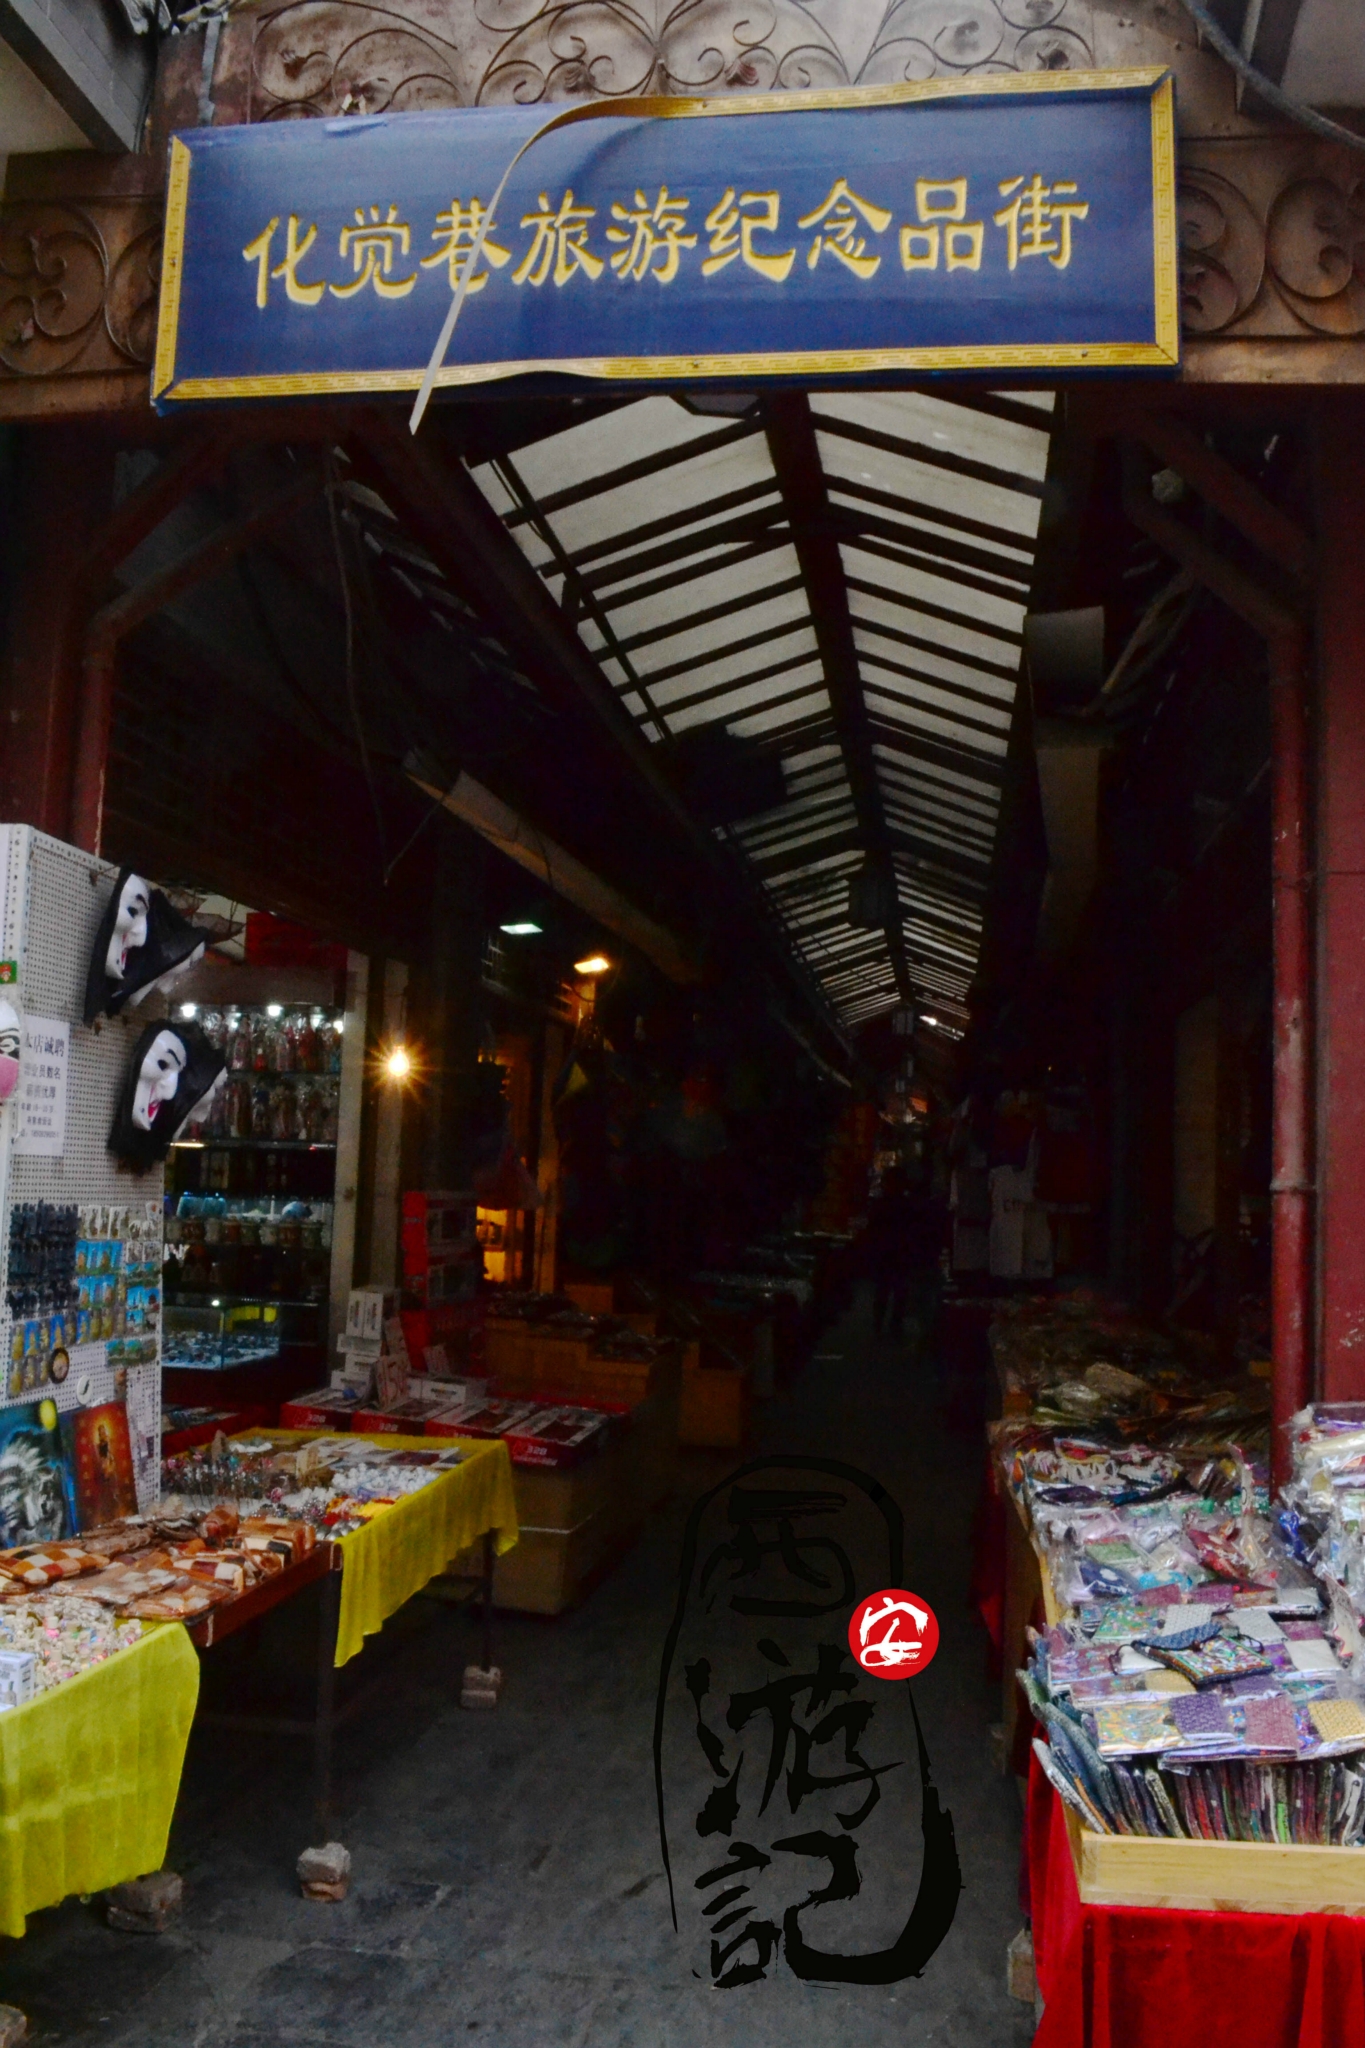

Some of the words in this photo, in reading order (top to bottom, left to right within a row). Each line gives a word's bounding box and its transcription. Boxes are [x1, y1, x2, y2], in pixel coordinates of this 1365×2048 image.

[241, 174, 1091, 309] 化觉巷旅游纪念品街
